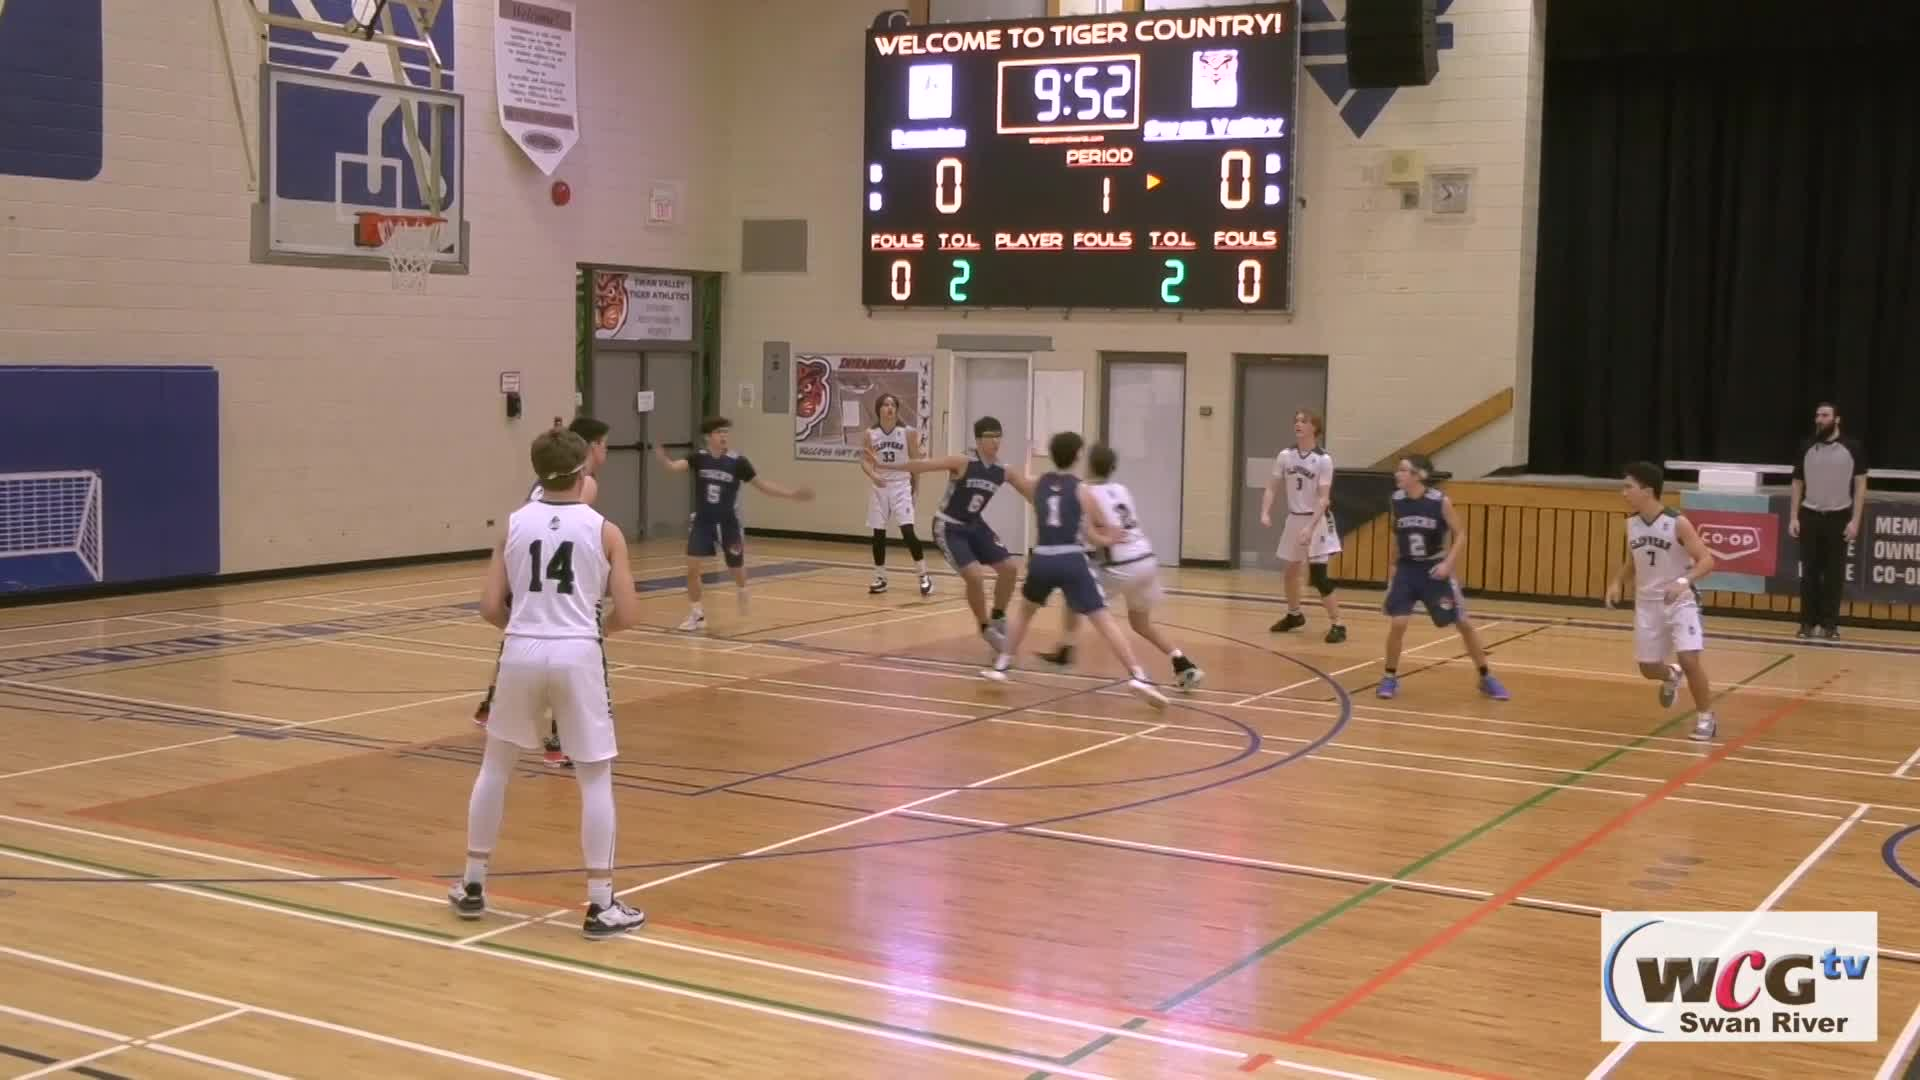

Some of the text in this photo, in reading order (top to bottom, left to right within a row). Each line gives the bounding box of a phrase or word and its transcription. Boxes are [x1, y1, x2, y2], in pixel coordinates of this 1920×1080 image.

[873, 13, 1282, 56] WELCOME TO TIGER COUNTRY!
[1033, 64, 1132, 122] 9:52
[1066, 148, 1134, 165] PERIOD
[936, 158, 962, 213] 0
[1220, 150, 1251, 210] 0
[871, 233, 925, 249] FOULS
[995, 232, 1132, 248] PLAYER FOULS
[1214, 231, 1277, 247] FOULS
[658, 279, 685, 289] VALLEY
[891, 260, 911, 301] 0
[949, 259, 970, 301] 2
[1161, 259, 1185, 303] 2
[1237, 259, 1261, 304] 0
[882, 451, 896, 463] 33
[707, 483, 721, 504] 5
[1046, 495, 1062, 527] 1
[1875, 516, 1920, 536] MEM
[1408, 533, 1427, 556] 2
[1702, 532, 1754, 546] CO-OP
[528, 539, 575, 595] 14
[1647, 551, 1656, 567] 7
